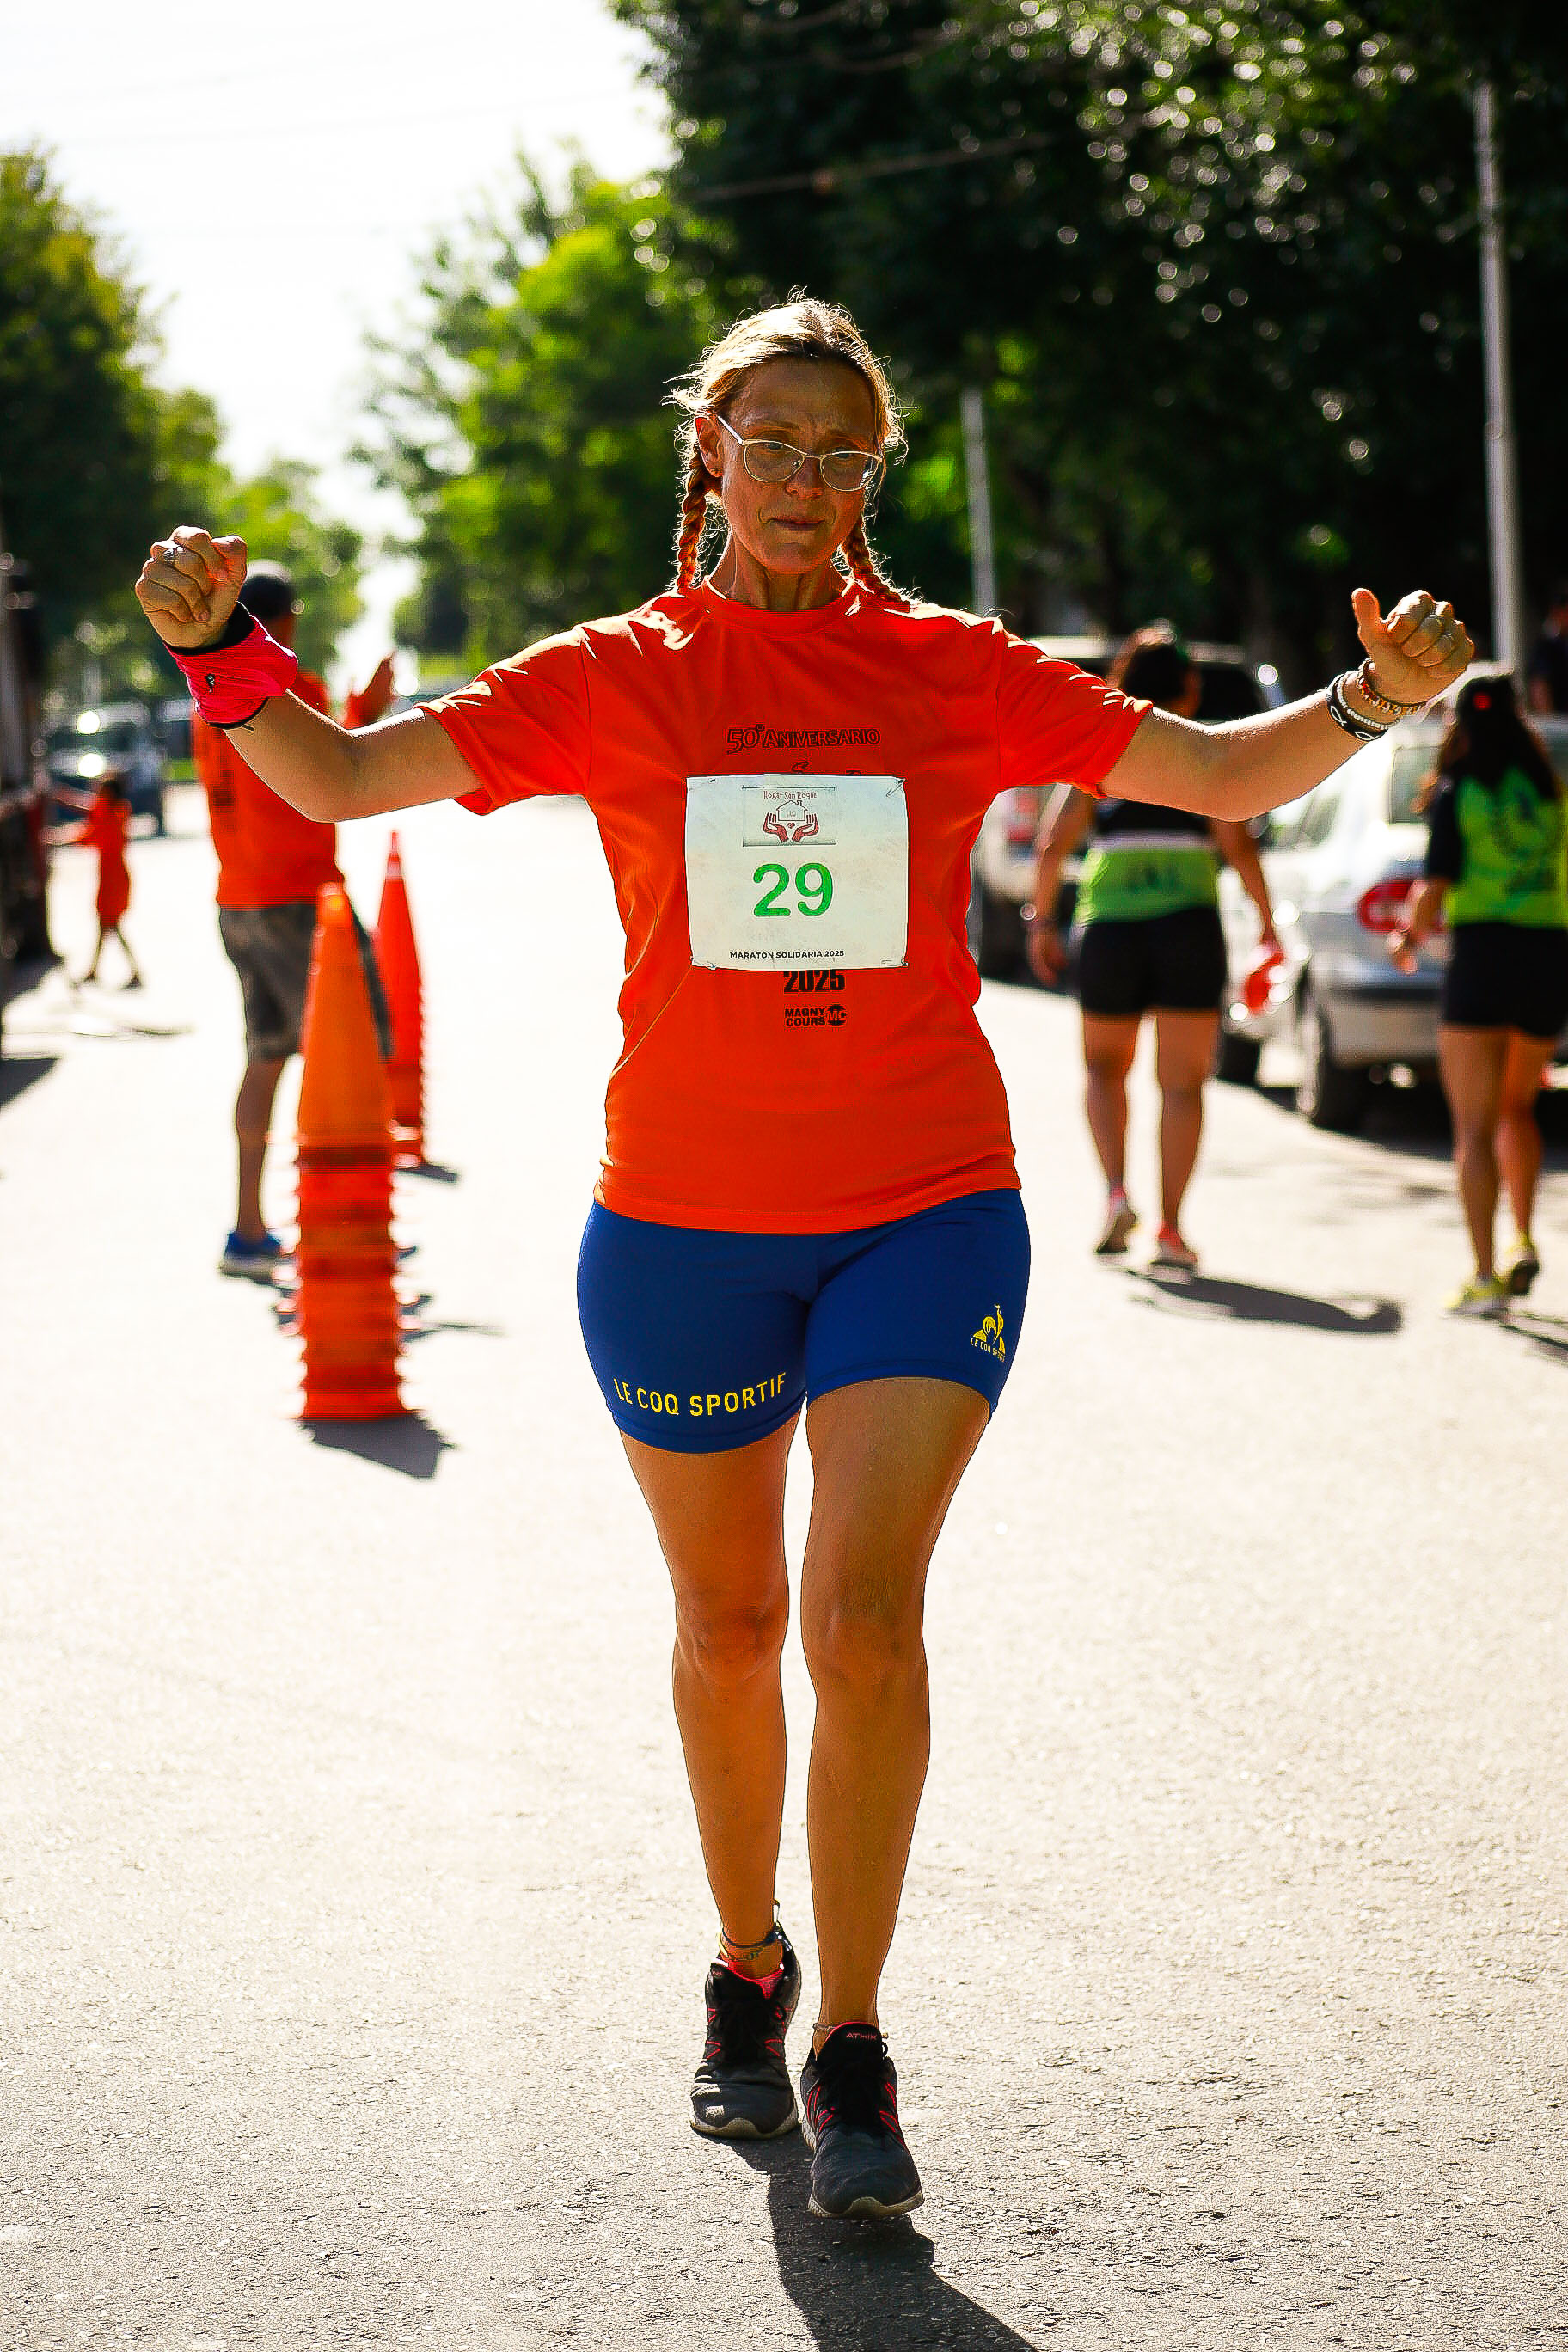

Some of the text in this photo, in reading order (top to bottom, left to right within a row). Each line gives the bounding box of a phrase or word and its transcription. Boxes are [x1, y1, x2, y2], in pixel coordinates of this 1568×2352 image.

[763, 728, 881, 749] ANIVERSARIO
[784, 791, 796, 800] San
[797, 790, 818, 800] Roque
[753, 862, 833, 917] 29
[730, 949, 845, 959] MARATON SOLIDARIA 2025
[783, 970, 846, 994] 2025
[784, 1008, 825, 1018] MAGNY
[785, 1017, 826, 1027] COURS
[970, 1337, 978, 1348] LE
[613, 1372, 787, 1417] LE COQ SPORTIF
